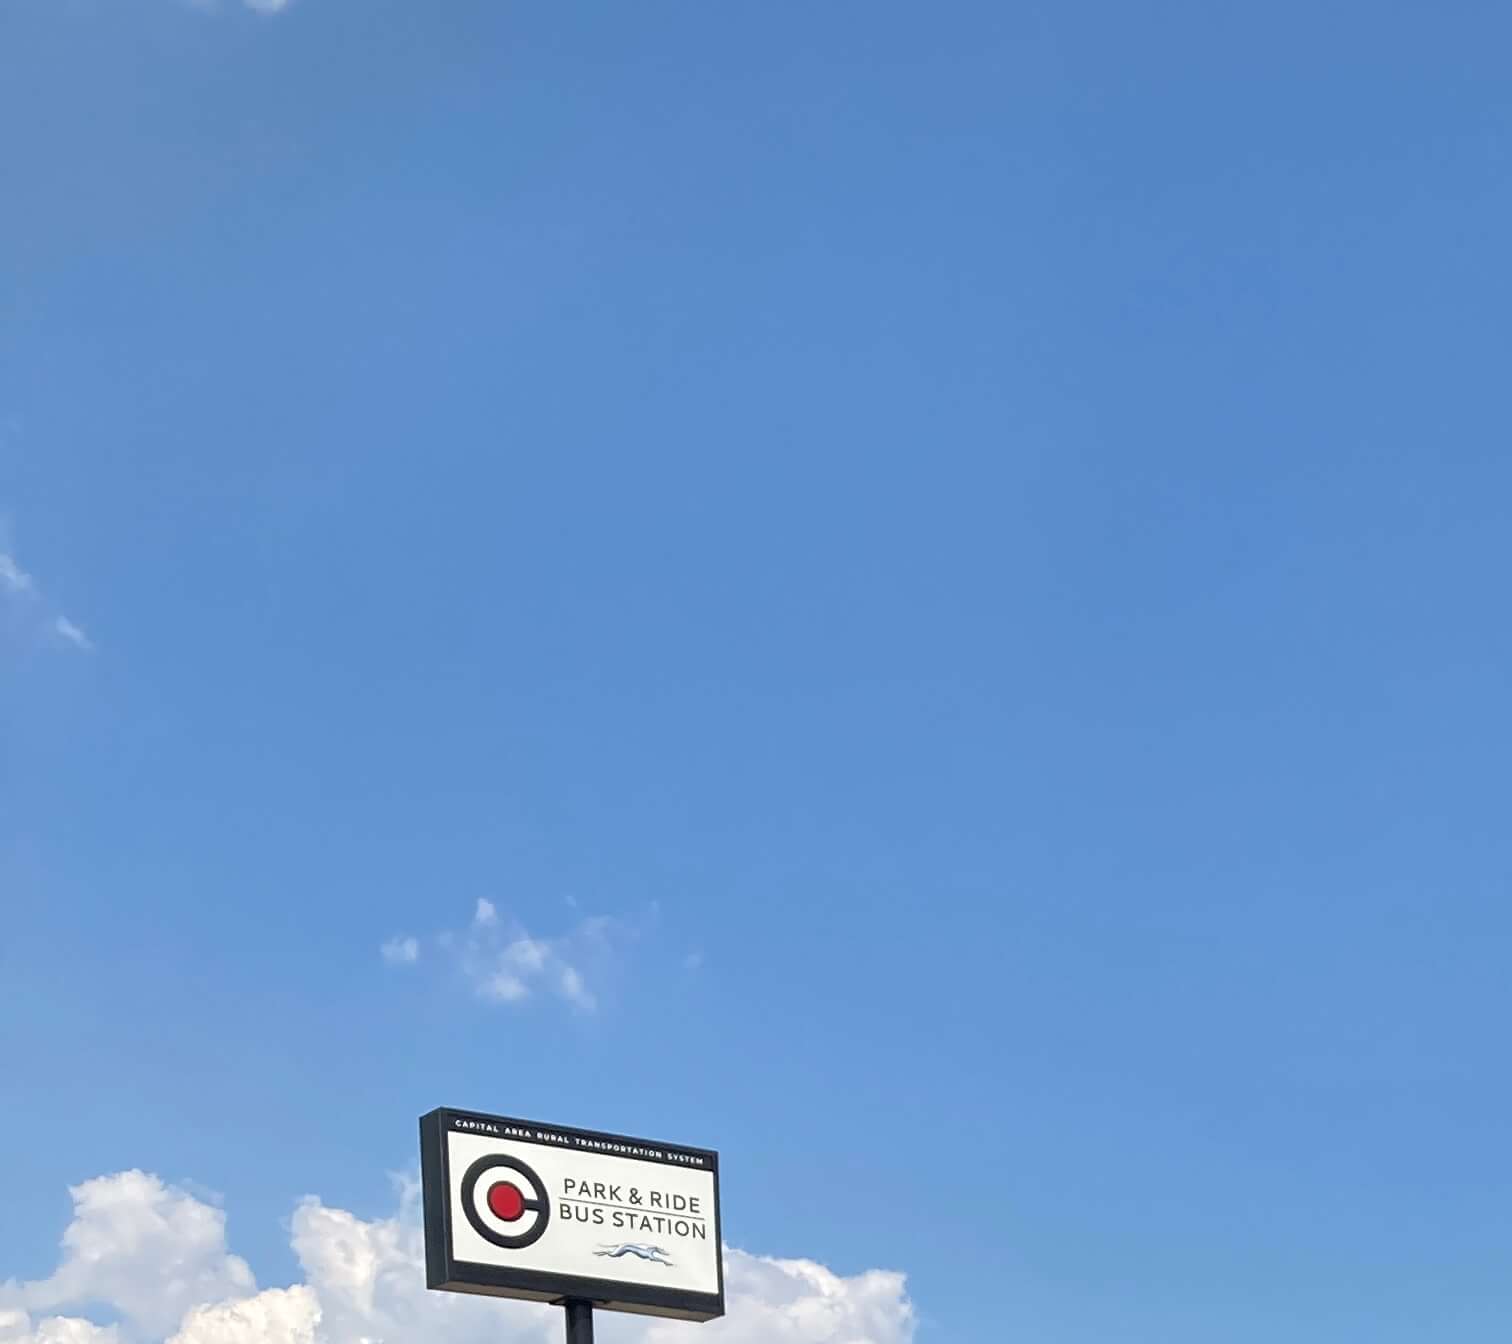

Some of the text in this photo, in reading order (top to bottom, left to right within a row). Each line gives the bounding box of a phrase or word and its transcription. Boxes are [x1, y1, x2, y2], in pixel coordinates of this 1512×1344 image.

[455, 1120, 704, 1165] CAPITAL AREA RURAL TRANSPORTATION SYSTEM
[564, 1178, 701, 1214] PARK & RIDE
[559, 1203, 706, 1241] BUS STATION
